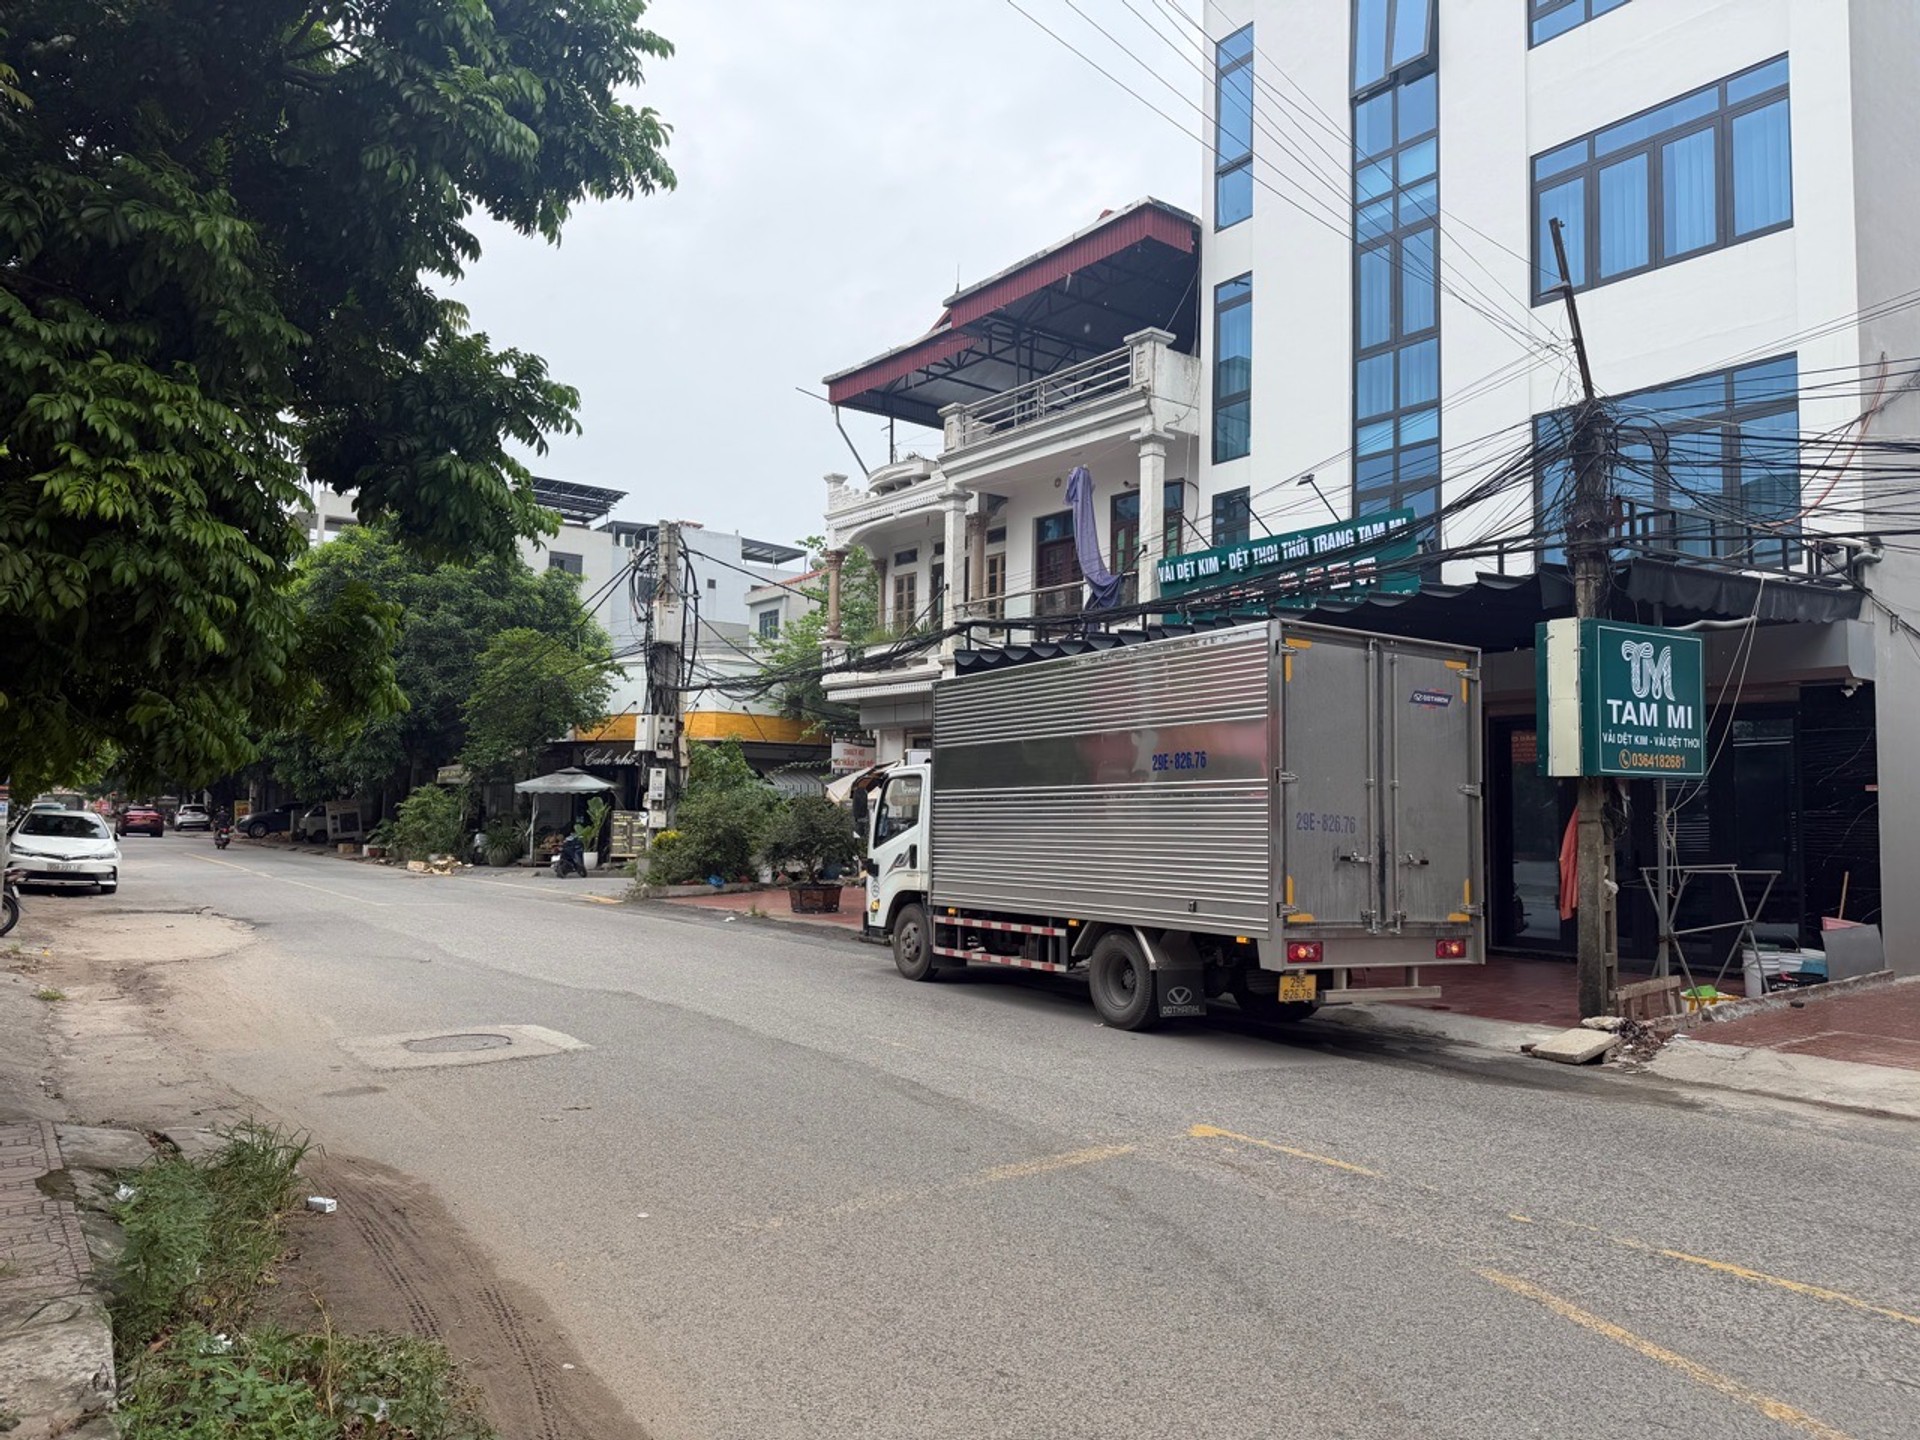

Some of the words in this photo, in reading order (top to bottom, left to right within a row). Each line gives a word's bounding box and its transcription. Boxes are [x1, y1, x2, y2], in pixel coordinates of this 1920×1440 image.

[1158, 560, 1176, 583] VẢI
[1177, 559, 1195, 582] DỆT
[1198, 556, 1220, 576] KIM
[1228, 548, 1250, 572] DỆT
[1312, 527, 1356, 552] TRANG
[1607, 699, 1659, 728] TAM
[1667, 705, 1694, 730] MI
[1602, 729, 1616, 744] VẢI
[1617, 732, 1633, 748] DỆT
[1634, 735, 1648, 746] KIM
[1654, 733, 1668, 747] VẢI
[1668, 735, 1683, 751] DỆT
[1152, 751, 1207, 771] 29E-826.76
[1296, 812, 1356, 835] 29E-826.76
